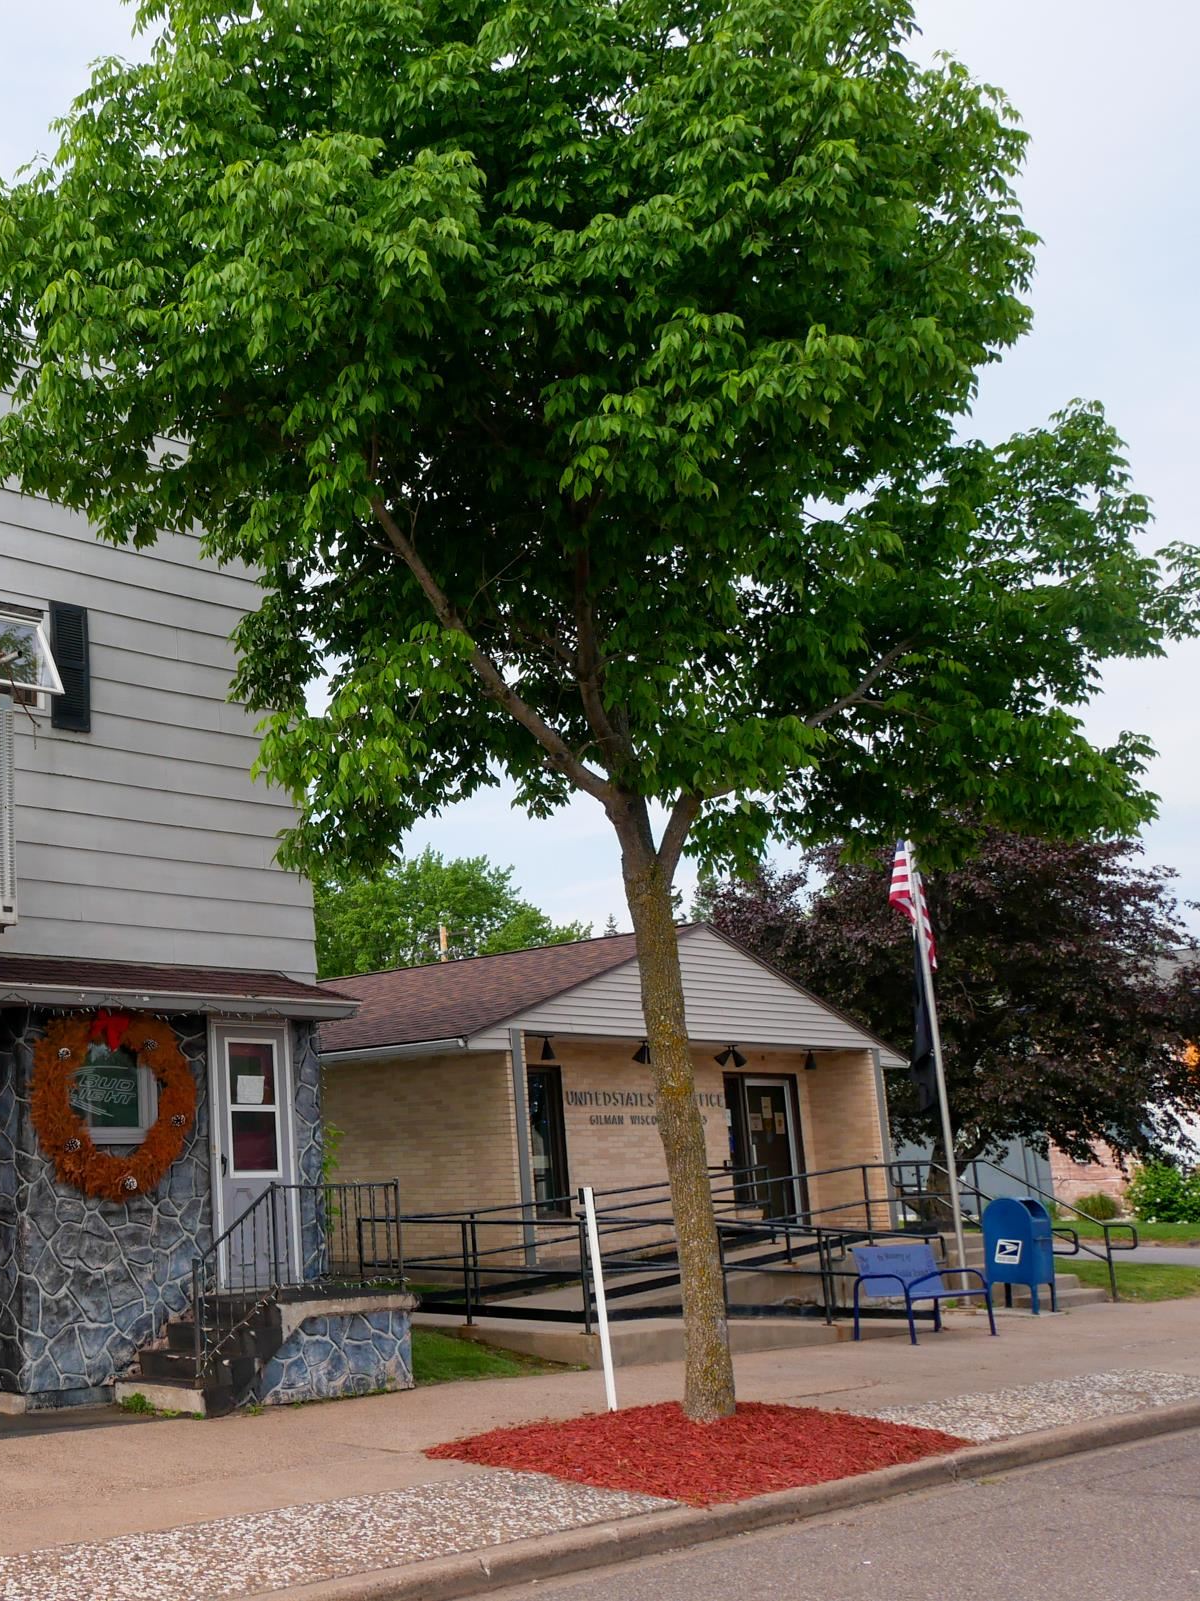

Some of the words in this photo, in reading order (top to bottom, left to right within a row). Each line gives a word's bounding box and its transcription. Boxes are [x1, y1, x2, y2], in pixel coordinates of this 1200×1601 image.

[79, 1074, 135, 1091] BUD
[590, 1114, 624, 1126] GILMAN
[630, 1114, 658, 1126] WISCO
